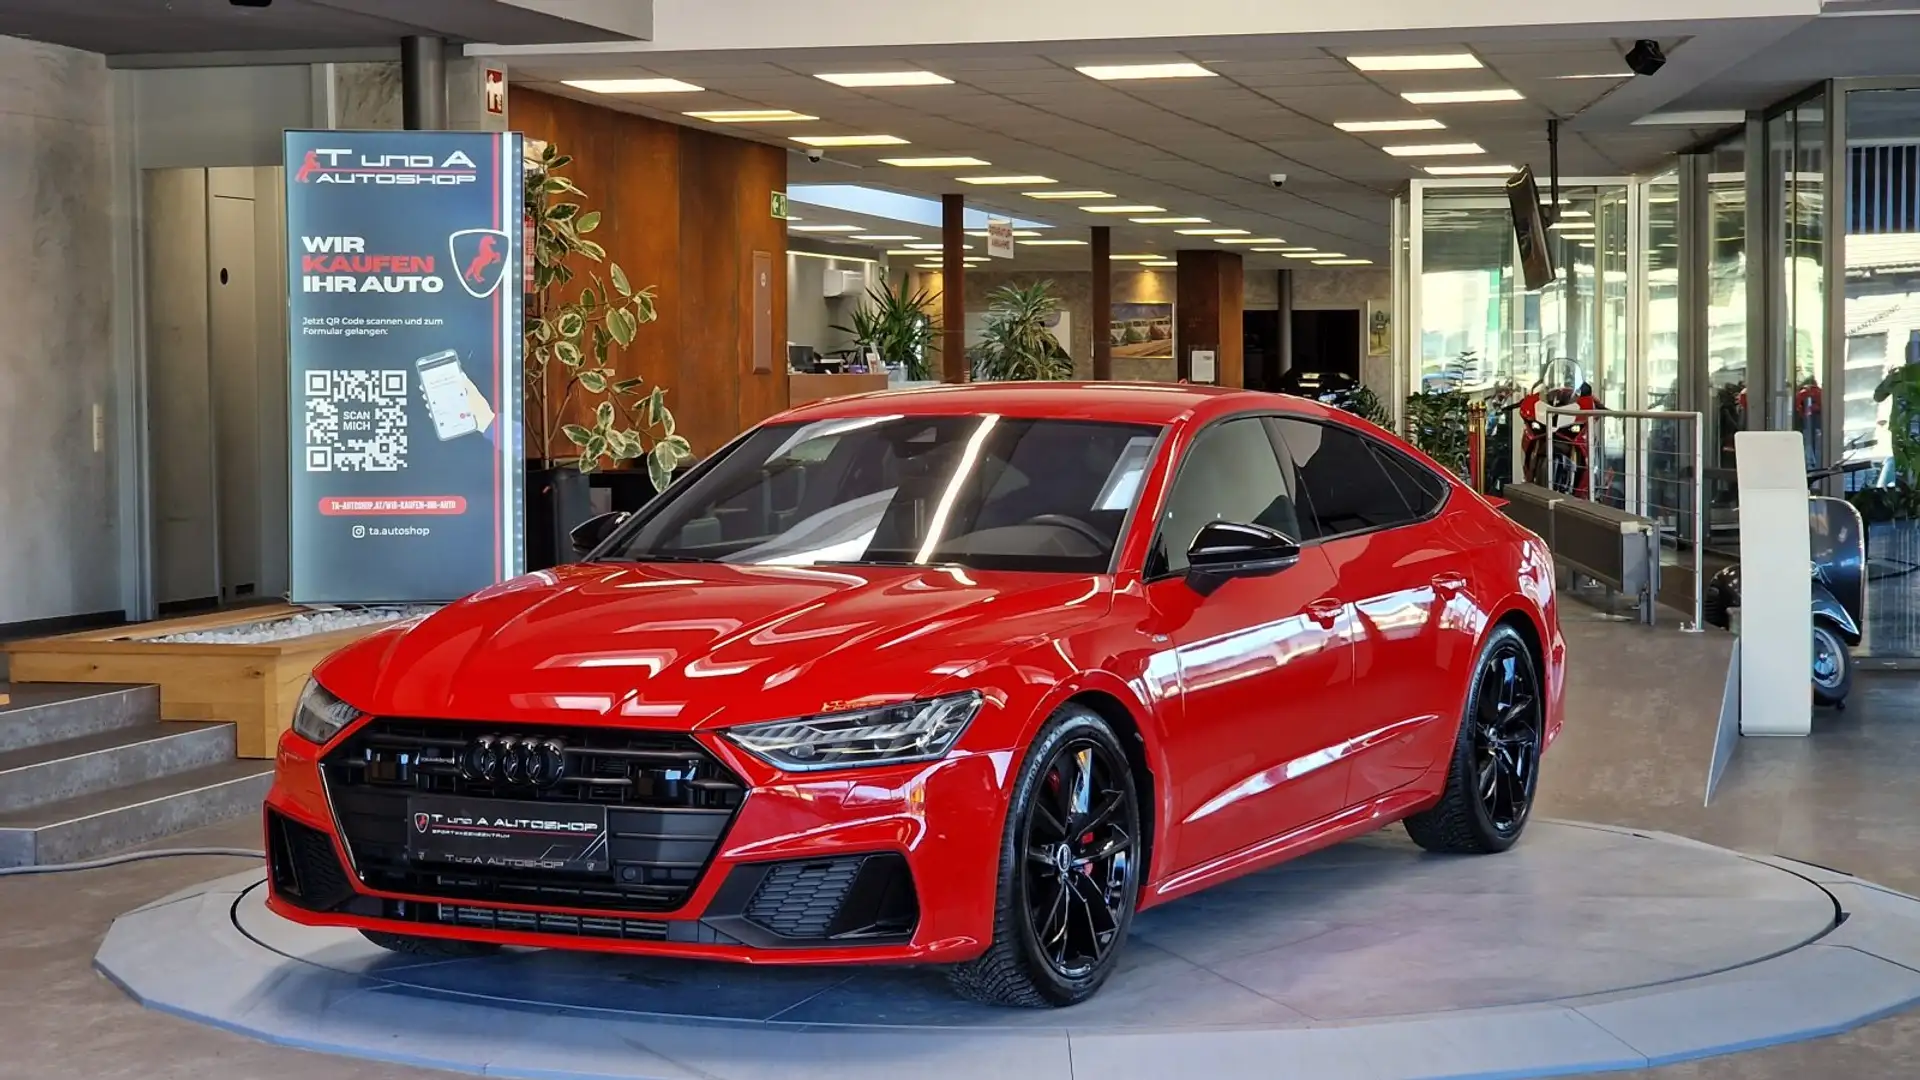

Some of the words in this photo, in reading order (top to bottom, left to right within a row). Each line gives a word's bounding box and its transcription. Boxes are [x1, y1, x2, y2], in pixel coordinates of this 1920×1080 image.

[315, 149, 352, 167] T
[440, 150, 477, 168] A
[315, 173, 477, 185] AUTOSHOP
[301, 236, 365, 253] WIR
[302, 255, 435, 273] KAUFEN
[302, 276, 357, 293] IHR
[360, 276, 444, 293] AUTO
[302, 316, 325, 326] Jetzt
[326, 317, 340, 327] QR
[341, 316, 365, 326] Code
[366, 317, 404, 326] scannen
[404, 316, 423, 326] und
[423, 318, 444, 326] zum
[302, 326, 343, 336] Formular
[344, 326, 389, 338] gelangen:
[343, 410, 371, 420] SCAN
[343, 421, 371, 431] MICH
[368, 525, 431, 537] ta.autoshop
[431, 813, 444, 823] T
[476, 817, 489, 826] A
[493, 818, 599, 832] AUTOSHOP
[445, 854, 455, 863] T
[472, 855, 484, 865] A
[486, 856, 565, 869] AUTOSHOP
